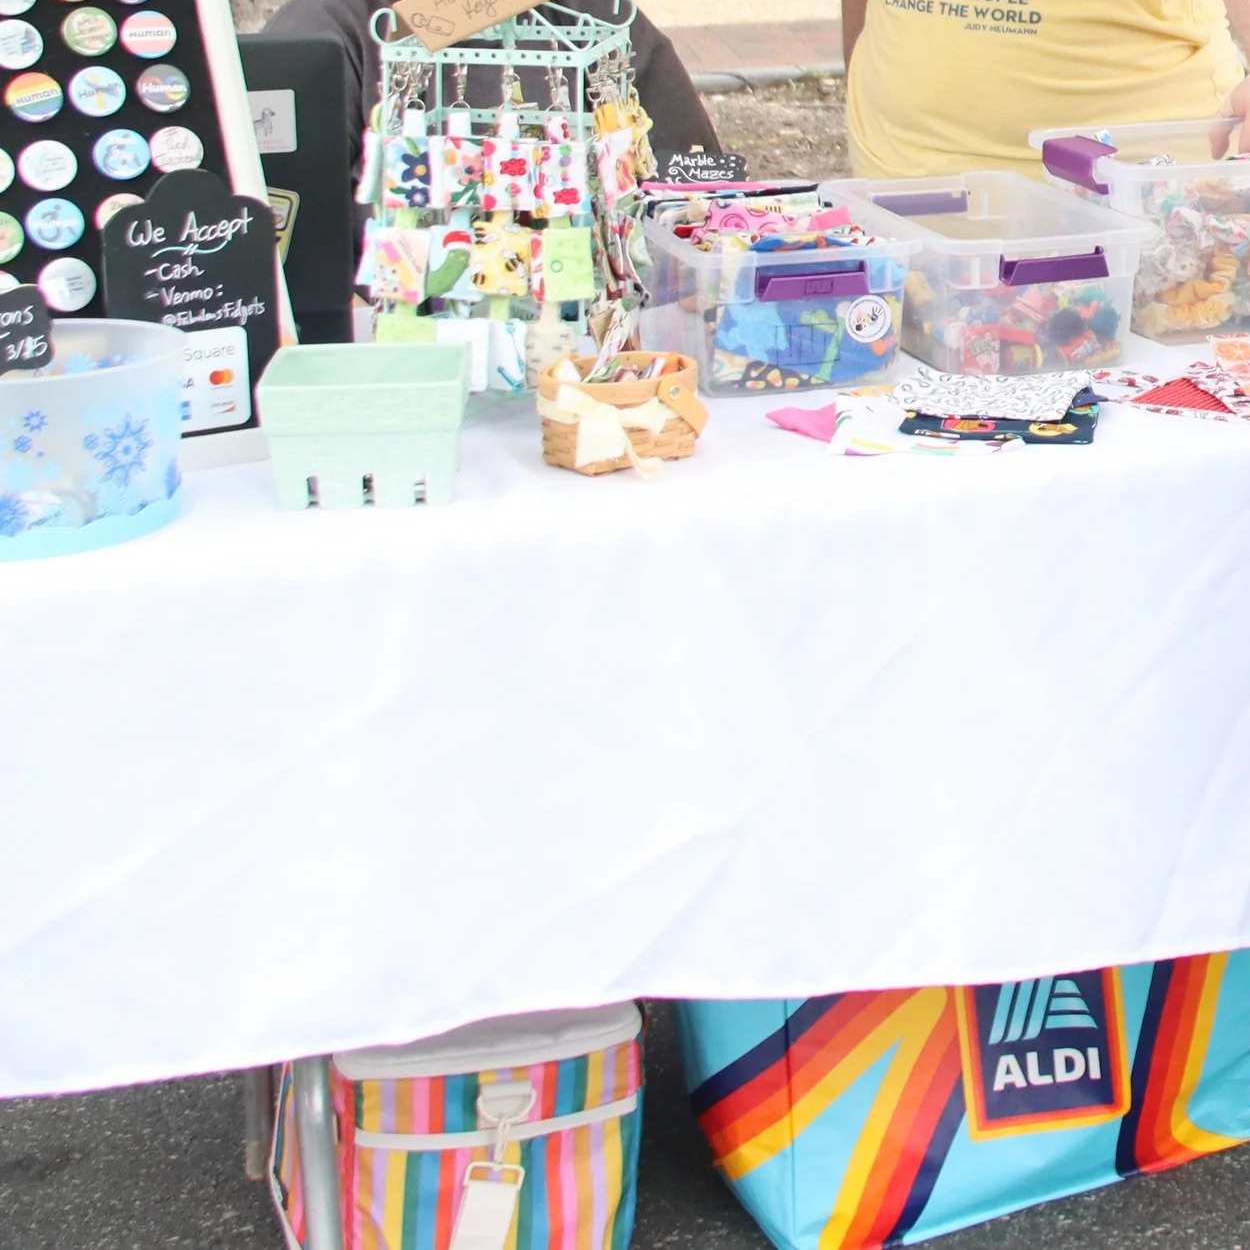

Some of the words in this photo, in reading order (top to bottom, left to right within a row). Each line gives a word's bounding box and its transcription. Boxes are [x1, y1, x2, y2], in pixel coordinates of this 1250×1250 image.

[939, 2, 969, 18] THE
[974, 6, 1042, 25] WORLD
[964, 23, 986, 31] JUDY
[990, 25, 1038, 35] HEUMANN
[668, 154, 716, 166] Marble
[689, 168, 734, 179] Mazes
[128, 219, 166, 246] We
[180, 207, 253, 243] Accept
[184, 344, 236, 362] Square
[992, 1047, 1101, 1091] ALDI
